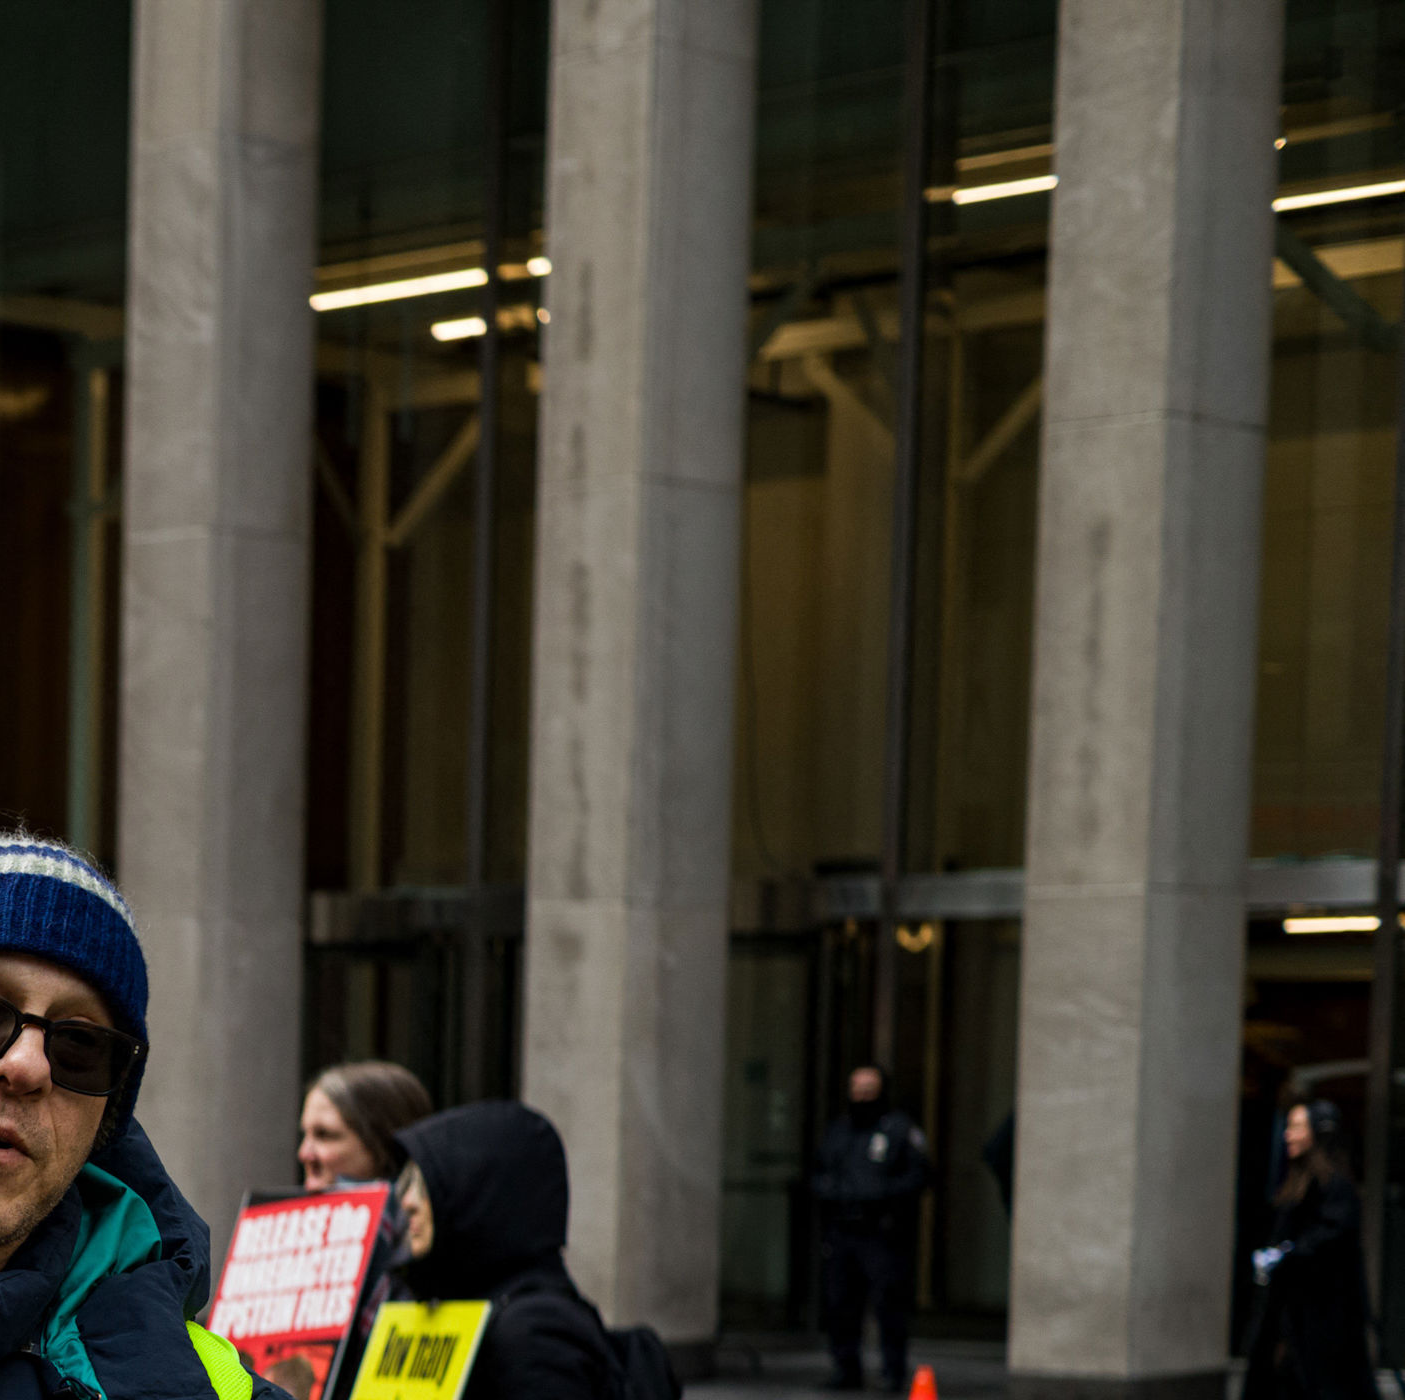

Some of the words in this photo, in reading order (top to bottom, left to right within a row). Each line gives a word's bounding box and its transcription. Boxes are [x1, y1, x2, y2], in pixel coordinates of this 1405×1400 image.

[232, 1204, 330, 1258] RELEASE
[327, 1201, 371, 1246] the
[219, 1241, 364, 1300] UNREDACTED
[208, 1292, 299, 1340] EPSTEIN
[294, 1285, 356, 1331] FILES
